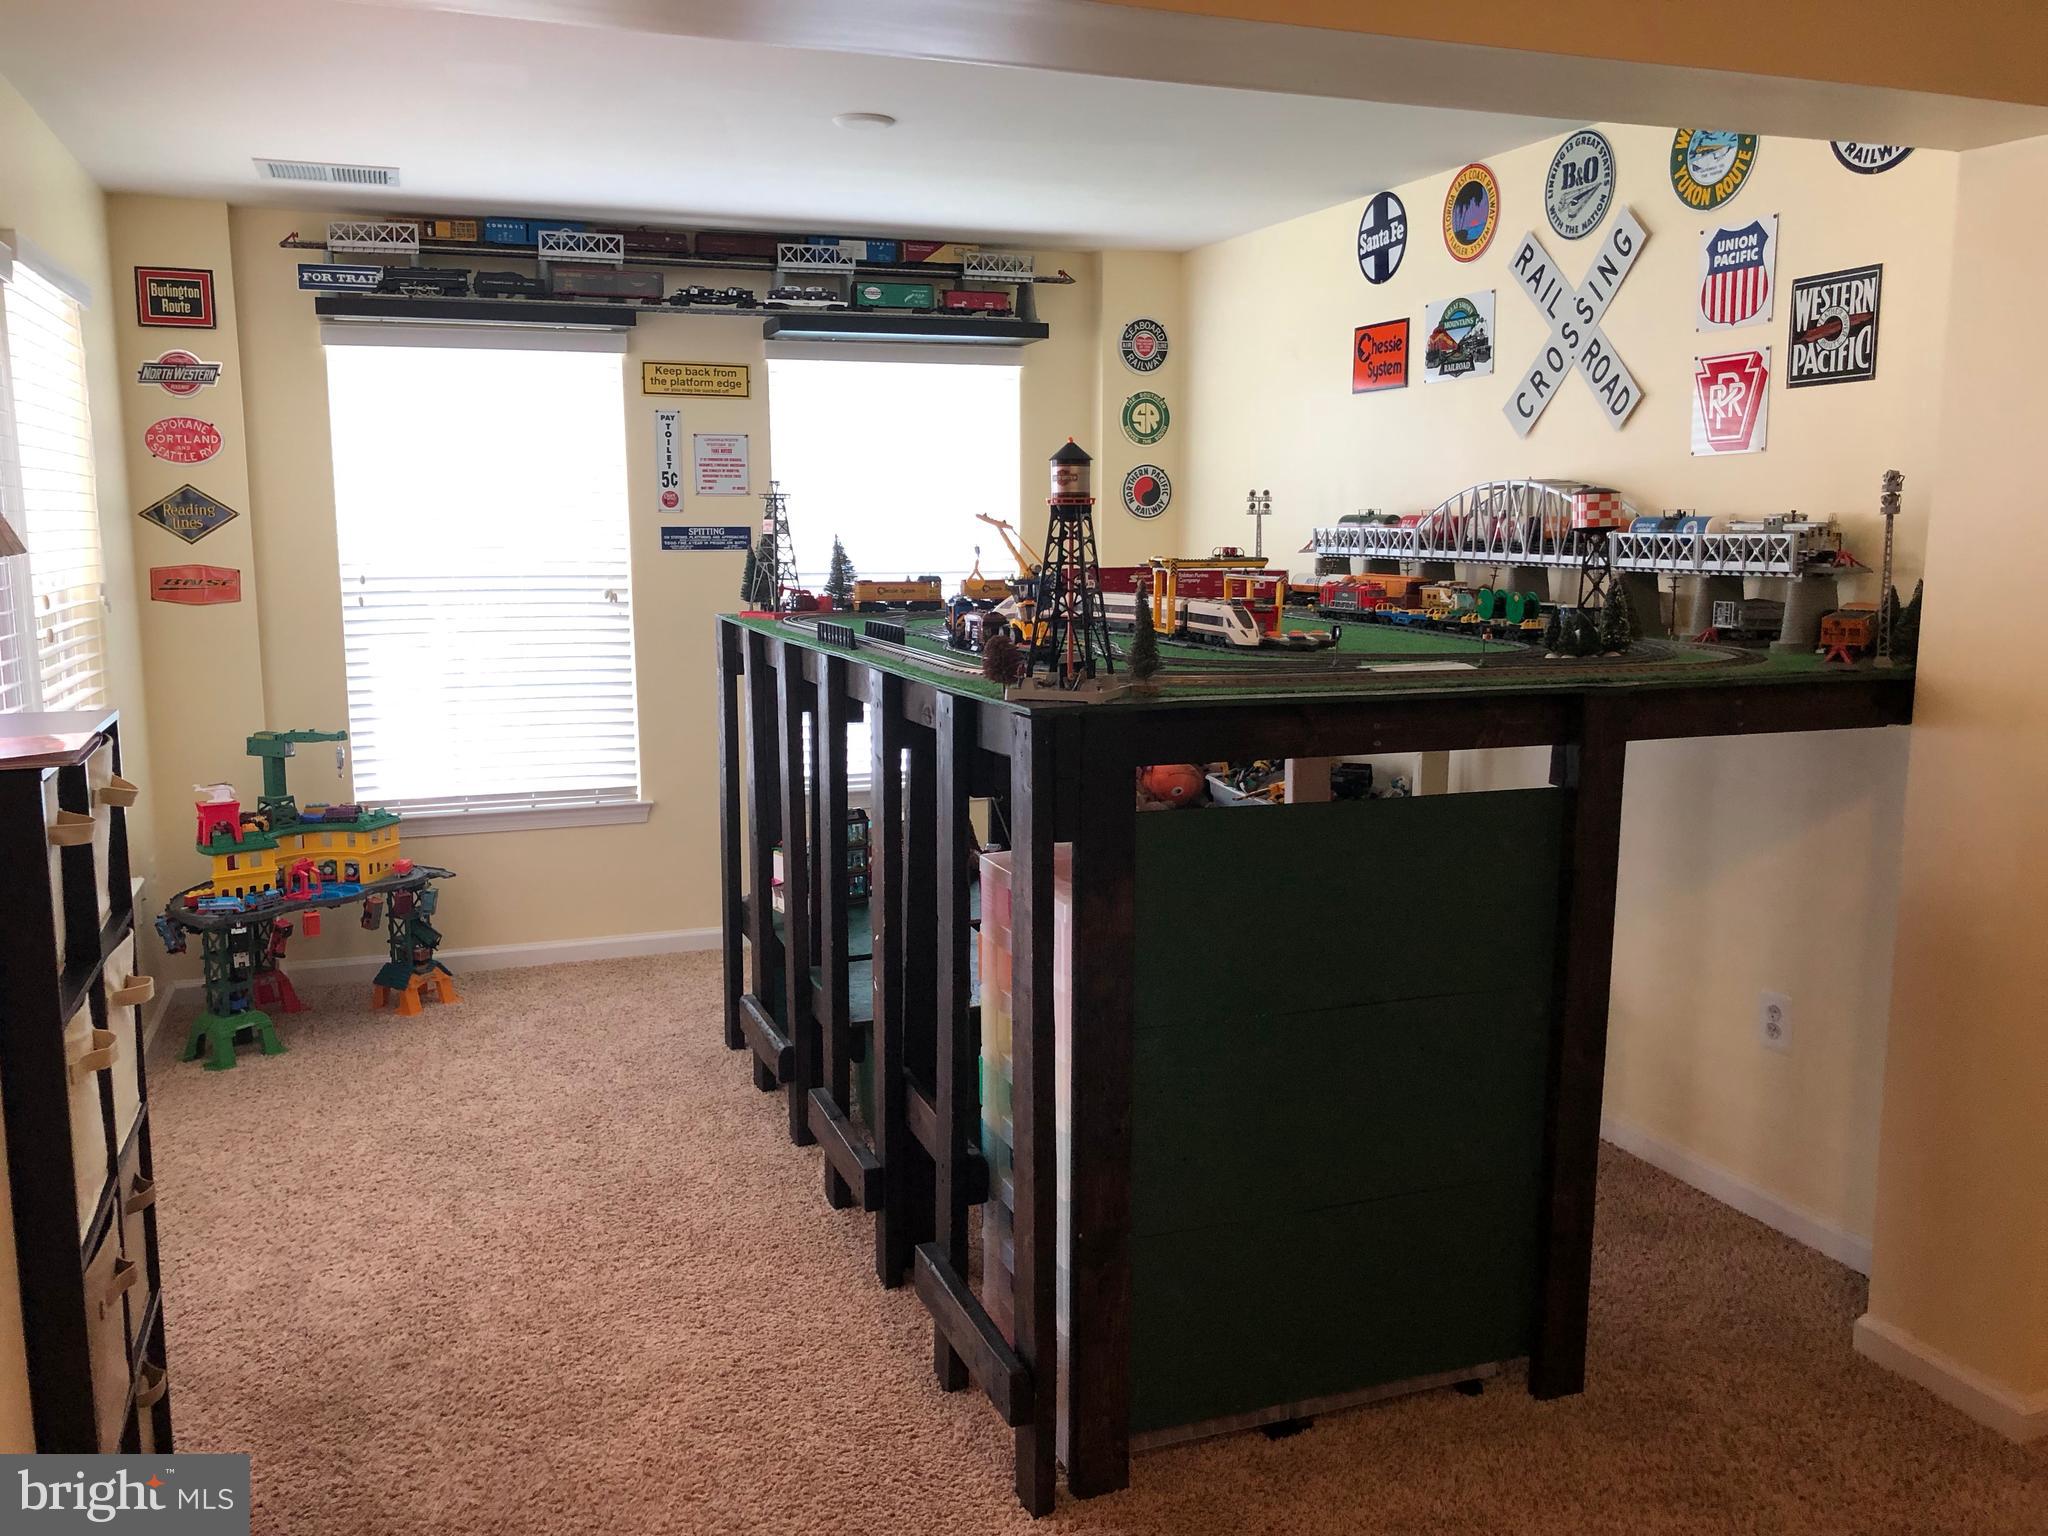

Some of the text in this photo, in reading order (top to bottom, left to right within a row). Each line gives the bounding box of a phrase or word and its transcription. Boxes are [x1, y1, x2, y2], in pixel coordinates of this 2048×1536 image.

[1548, 136, 1610, 199] LINKING 13 GREAT STATES
[1561, 155, 1599, 190] B&O
[1674, 150, 1752, 206] YUKON ROUTE
[1446, 170, 1496, 232] FLORIDA EAST COAST RAILWAY
[1549, 194, 1607, 234] WITH THE NATION
[1360, 221, 1404, 256] Santa Fe
[1470, 227, 1491, 254] SYSTEM
[1717, 234, 1758, 253] UNION
[1714, 247, 1758, 268] PACIFIC
[302, 272, 333, 282] FOR
[150, 282, 200, 300] Burlington
[161, 298, 191, 313] Route
[1795, 277, 1876, 333] WESTERN
[1125, 321, 1165, 341] SEABOARD
[1516, 228, 1632, 418] CROSSING
[1358, 332, 1403, 363] Chessie
[1792, 325, 1872, 376] PACIFIC
[1127, 353, 1162, 370] RAILWAY
[1367, 360, 1402, 382] System
[1444, 361, 1471, 373] RAILROAD
[655, 366, 737, 377] Keep back from
[650, 377, 742, 390] the platform edge
[155, 419, 210, 434] SPOKANE
[147, 434, 219, 444] PORTLAND
[151, 443, 198, 462] SEATTLE
[662, 471, 678, 488] 5¢
[1126, 467, 1169, 504] NORTHERN PACIFIC
[163, 503, 216, 517] Reading
[1135, 499, 1165, 515] RAILWAY
[688, 527, 725, 536] SPITTING
